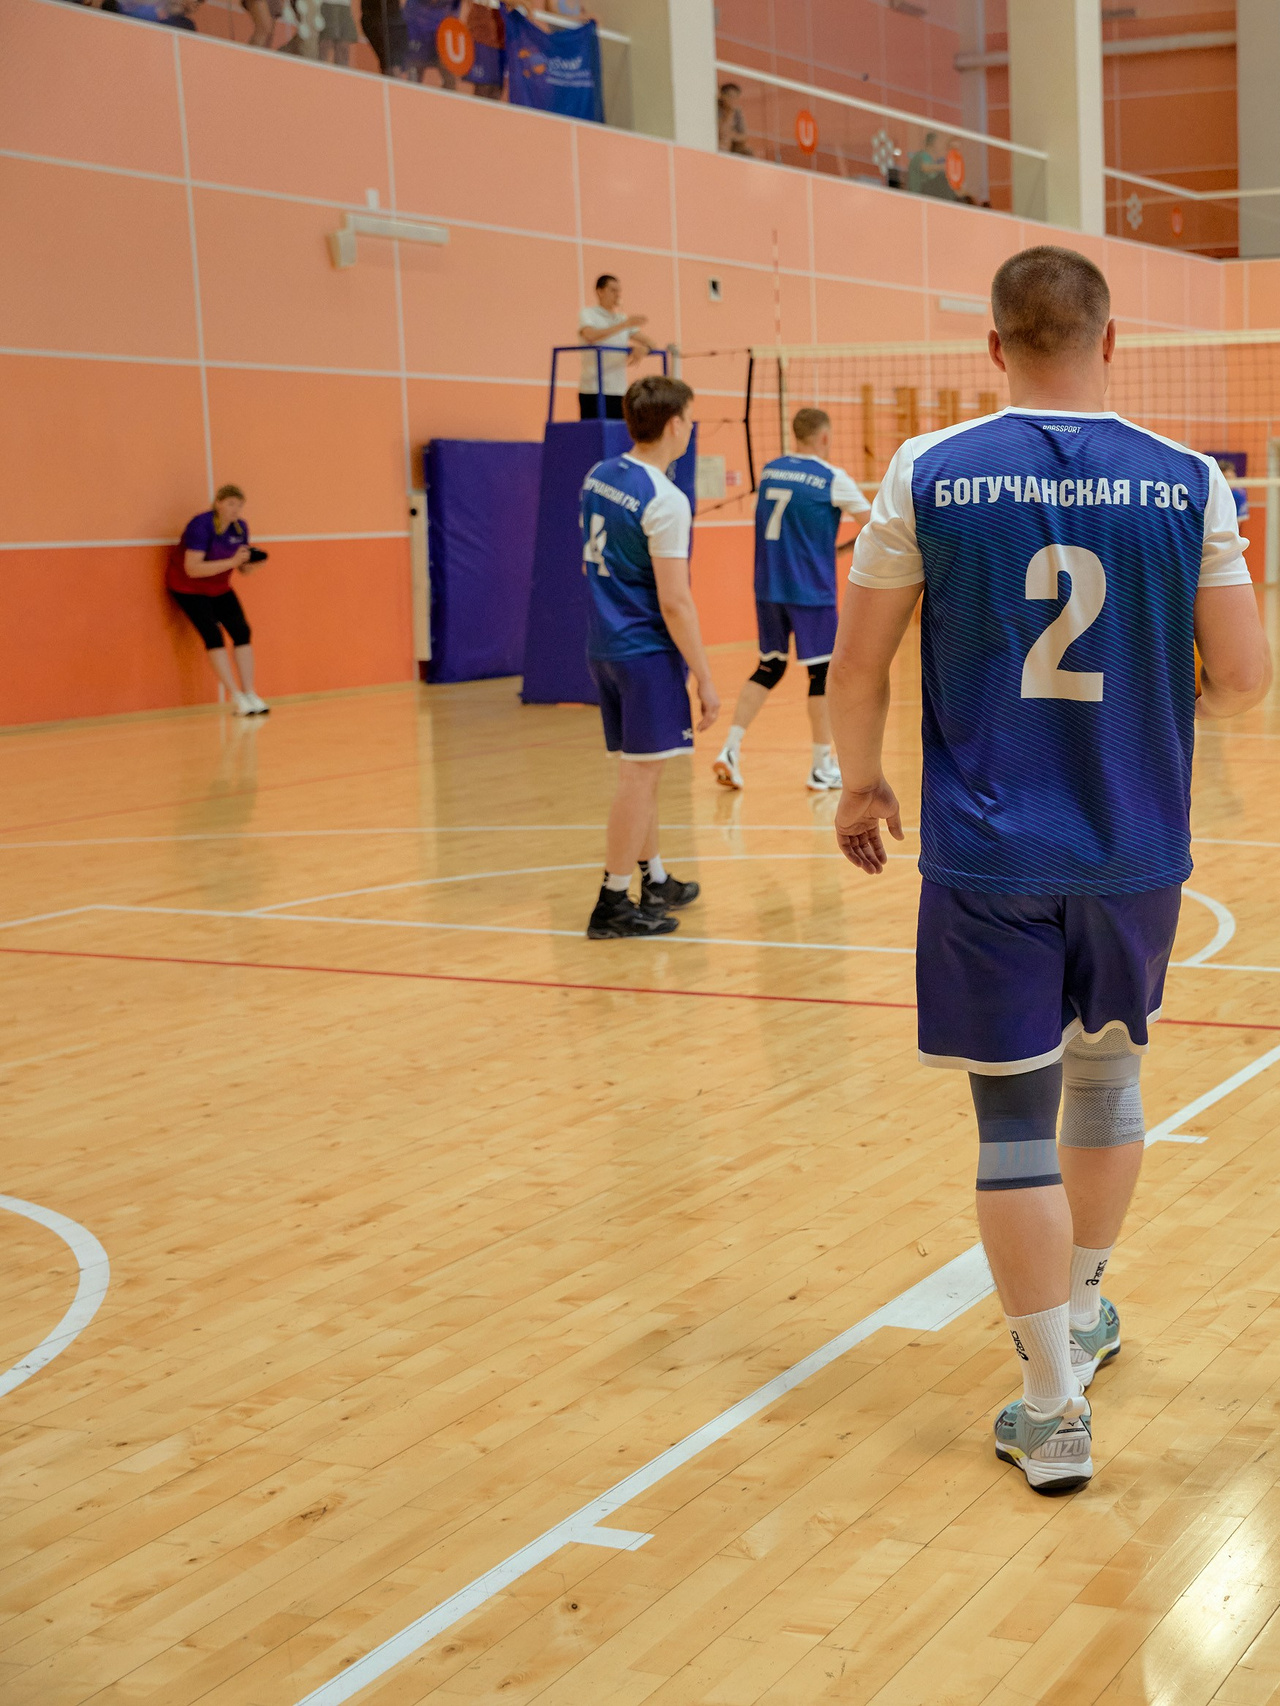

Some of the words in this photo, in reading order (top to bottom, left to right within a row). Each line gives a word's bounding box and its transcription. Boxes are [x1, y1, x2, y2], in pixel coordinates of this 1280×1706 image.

[445, 29, 466, 64] U
[799, 117, 814, 147] U
[765, 487, 793, 540] 7
[935, 476, 1130, 507] БОГУЧАНСКАЯ
[1139, 480, 1189, 511] ГЭС
[583, 512, 610, 577] 4
[1020, 544, 1107, 702] 2
